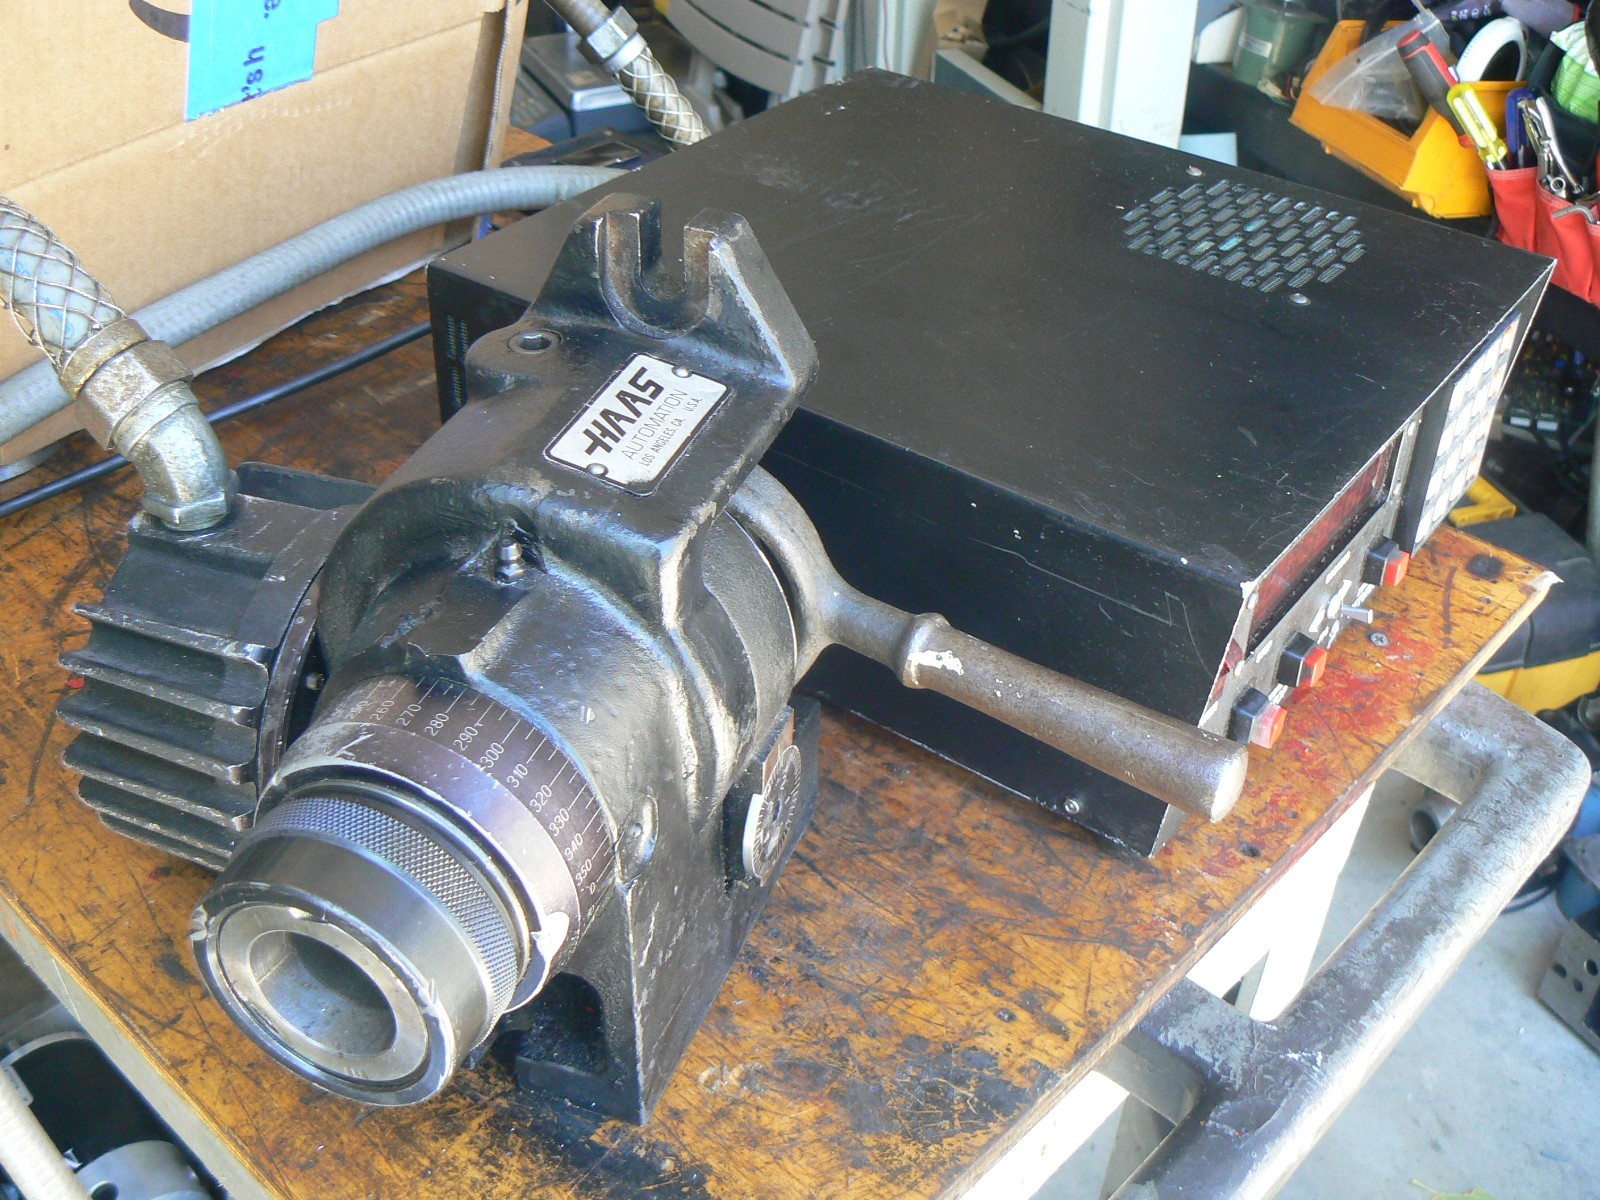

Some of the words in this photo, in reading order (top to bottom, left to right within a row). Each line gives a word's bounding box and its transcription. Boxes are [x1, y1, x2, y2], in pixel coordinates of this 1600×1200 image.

[583, 366, 664, 455] HAAS
[621, 389, 688, 460] AUTOMATION
[639, 453, 655, 466] LOS
[370, 700, 395, 721] 260
[396, 704, 421, 726] 270
[424, 713, 450, 736] 280
[453, 726, 478, 751] 290
[486, 742, 505, 769] 300
[506, 763, 528, 789] 310
[529, 784, 552, 813] 320
[549, 808, 570, 838] 330
[565, 832, 583, 861] 340
[576, 858, 592, 886] 350
